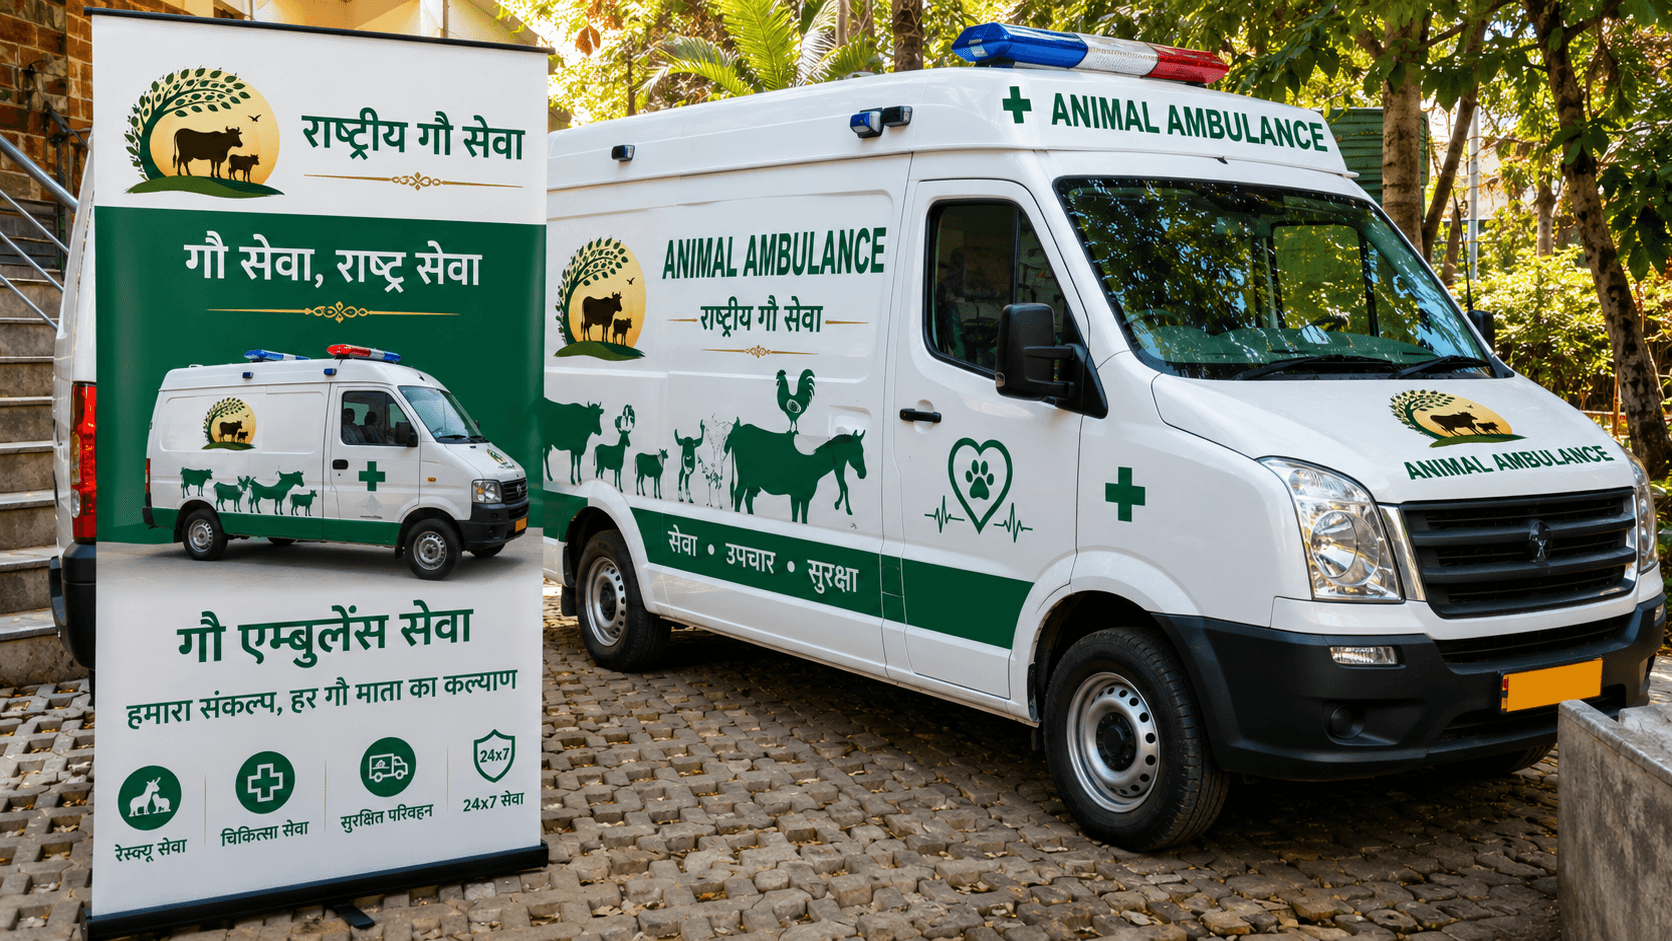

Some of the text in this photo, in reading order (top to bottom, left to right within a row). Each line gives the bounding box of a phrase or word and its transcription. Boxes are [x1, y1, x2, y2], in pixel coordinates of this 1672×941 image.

[301, 107, 527, 161] राष्ट्रीय गौ सेवा
[1051, 92, 1329, 152] ANIMAL AMBULANCE
[183, 230, 483, 293] गौ सेवा, राष्ट्र सेवा
[661, 226, 887, 280] ANIMAL AMBULANCE
[700, 294, 823, 338] राष्ट्रीय गौ सेवा
[1403, 445, 1615, 481] ANIMAL AMBULANCE
[667, 524, 860, 595] सेवा उपचार सुरक्षा
[176, 599, 474, 669] गौ एम्बुलेंस सेवा
[125, 668, 518, 730] हमारा संकल्प, हर गौ माता का कल्याण
[479, 746, 510, 764] 24x7
[341, 803, 434, 833] सुरक्षित परिवहन
[462, 790, 525, 812] 24x7 सेवा
[114, 837, 187, 863] रेस्क्यू सेवा
[220, 819, 309, 846] चिकित्सा सेवा
